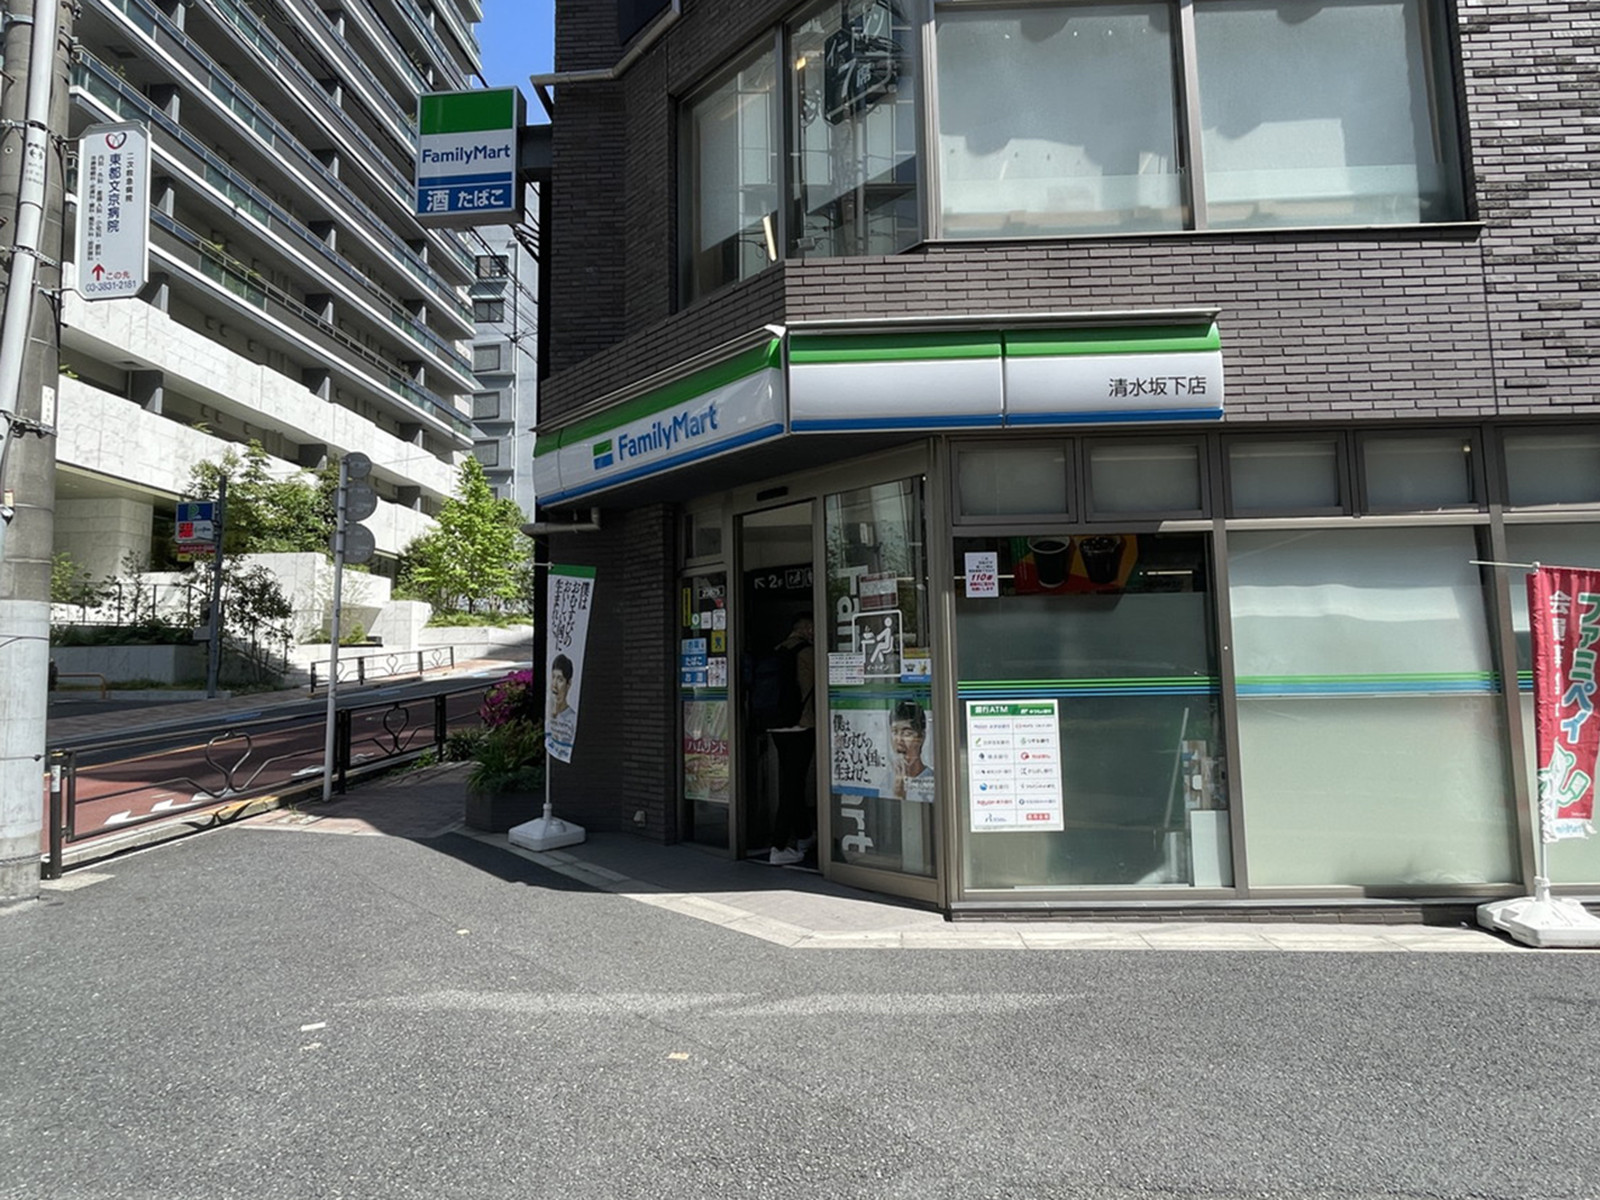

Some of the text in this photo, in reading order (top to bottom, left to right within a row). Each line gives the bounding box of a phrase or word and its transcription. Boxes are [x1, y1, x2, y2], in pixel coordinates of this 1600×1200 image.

[422, 144, 511, 164] FamilyMart
[107, 153, 121, 233] 東都文京病院
[426, 189, 504, 212] 酒 たばこ
[106, 271, 130, 281] この先
[1109, 376, 1207, 397] 清水坂下店
[617, 404, 718, 461] FamilyMart
[1561, 592, 1600, 743] ファミペイ
